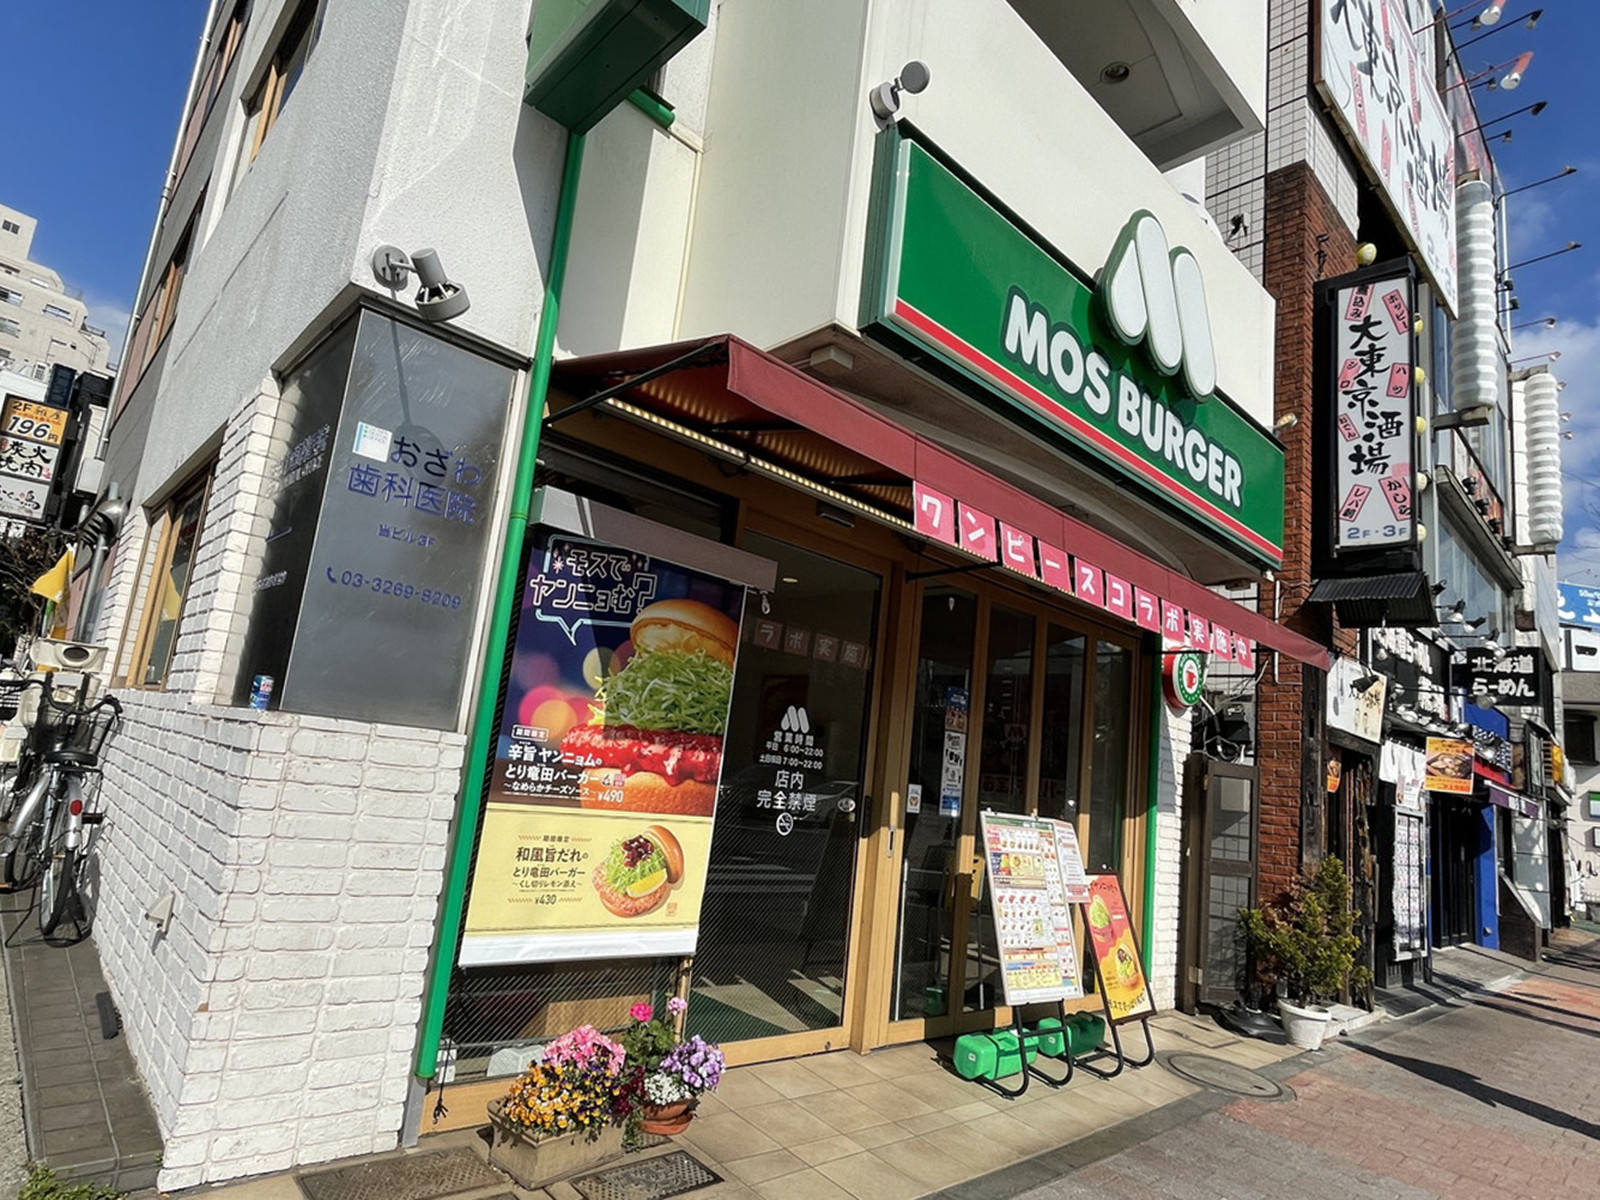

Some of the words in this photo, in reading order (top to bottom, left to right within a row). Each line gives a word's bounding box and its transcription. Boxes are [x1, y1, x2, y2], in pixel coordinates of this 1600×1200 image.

[1005, 295, 1110, 415] MOS
[1118, 375, 1242, 507] BURGER
[1342, 314, 1403, 476] 大東京酒場
[12, 401, 33, 413] 2F
[390, 436, 483, 485] おざわ
[348, 464, 477, 525] 歯科医院
[1472, 655, 1534, 674] 北海道
[1472, 678, 1535, 697] らーめん
[508, 744, 537, 762] 辛旨
[774, 770, 804, 790] 店内
[756, 789, 817, 812] 完全禁煙
